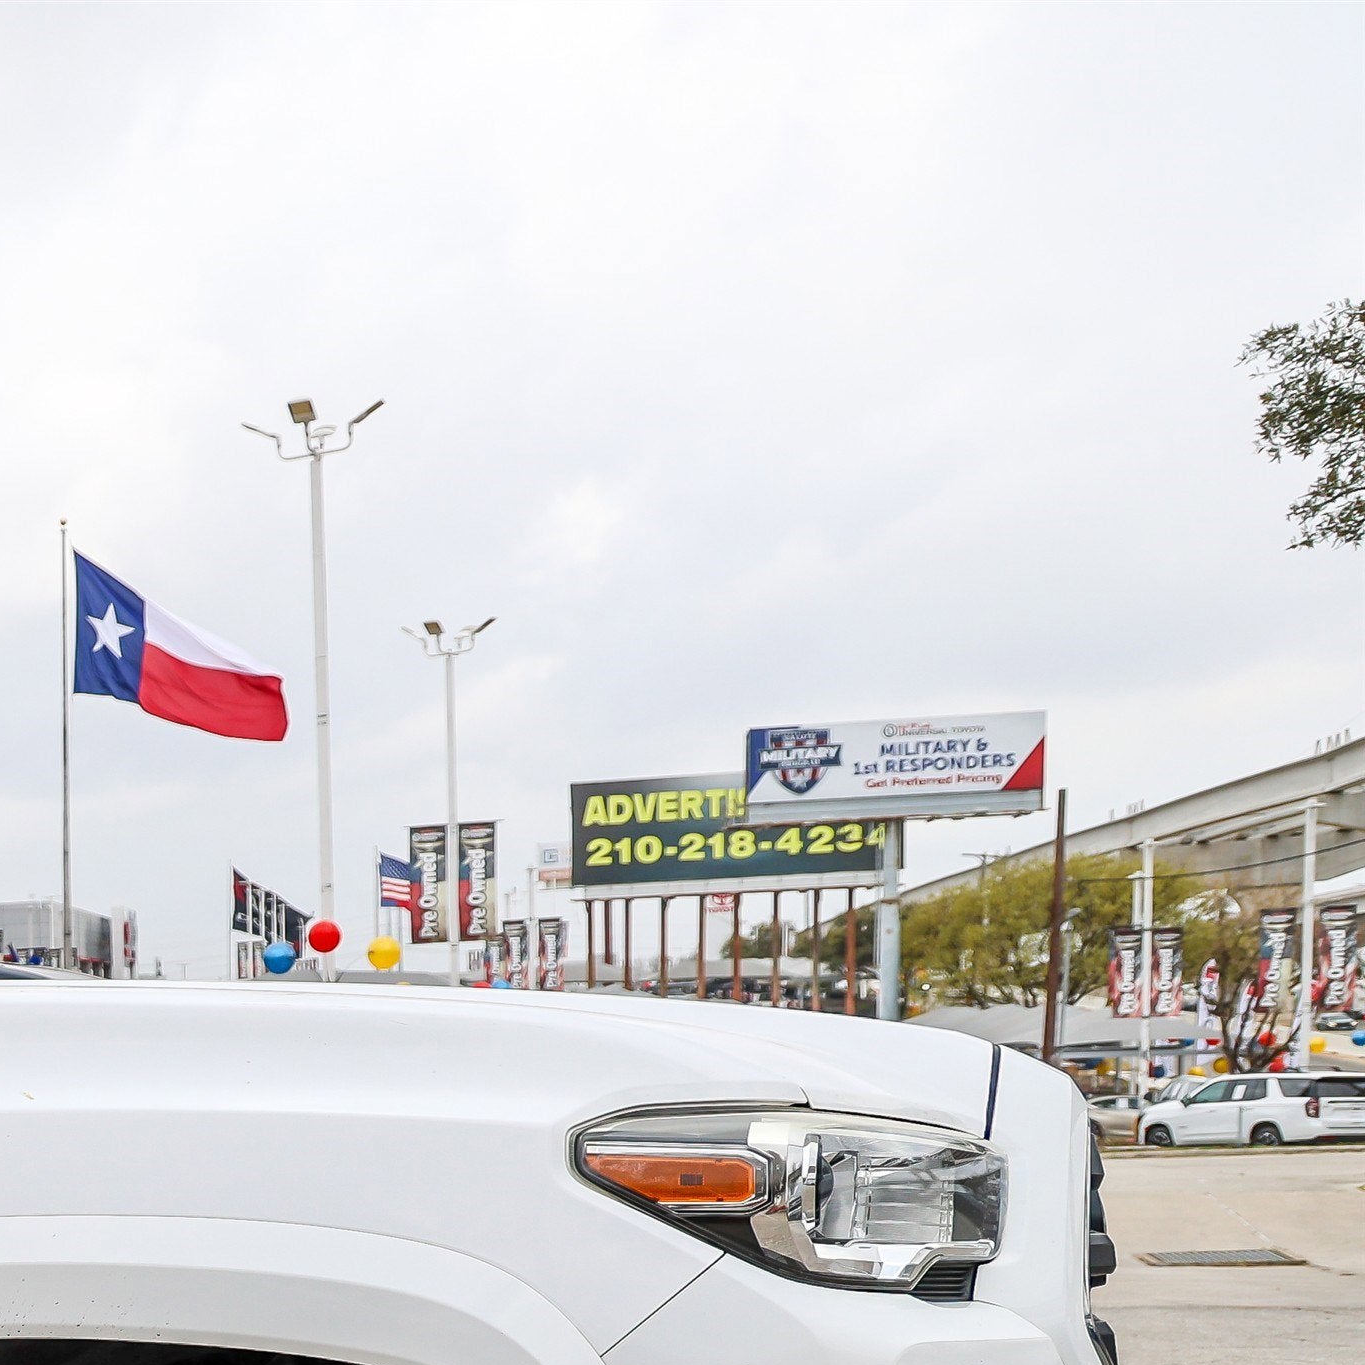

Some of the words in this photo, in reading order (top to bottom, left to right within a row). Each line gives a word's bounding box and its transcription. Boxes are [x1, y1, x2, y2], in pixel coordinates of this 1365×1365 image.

[761, 746, 839, 762] MILITARY
[880, 740, 970, 756] MILITARY
[977, 738, 988, 751] &
[854, 762, 877, 774] 1st
[886, 753, 1016, 772] RESPONDERS
[417, 852, 438, 908] Owned
[466, 849, 486, 905] Owned
[420, 910, 439, 937] Pre
[468, 908, 486, 935] Pre
[1327, 930, 1346, 979] Owned
